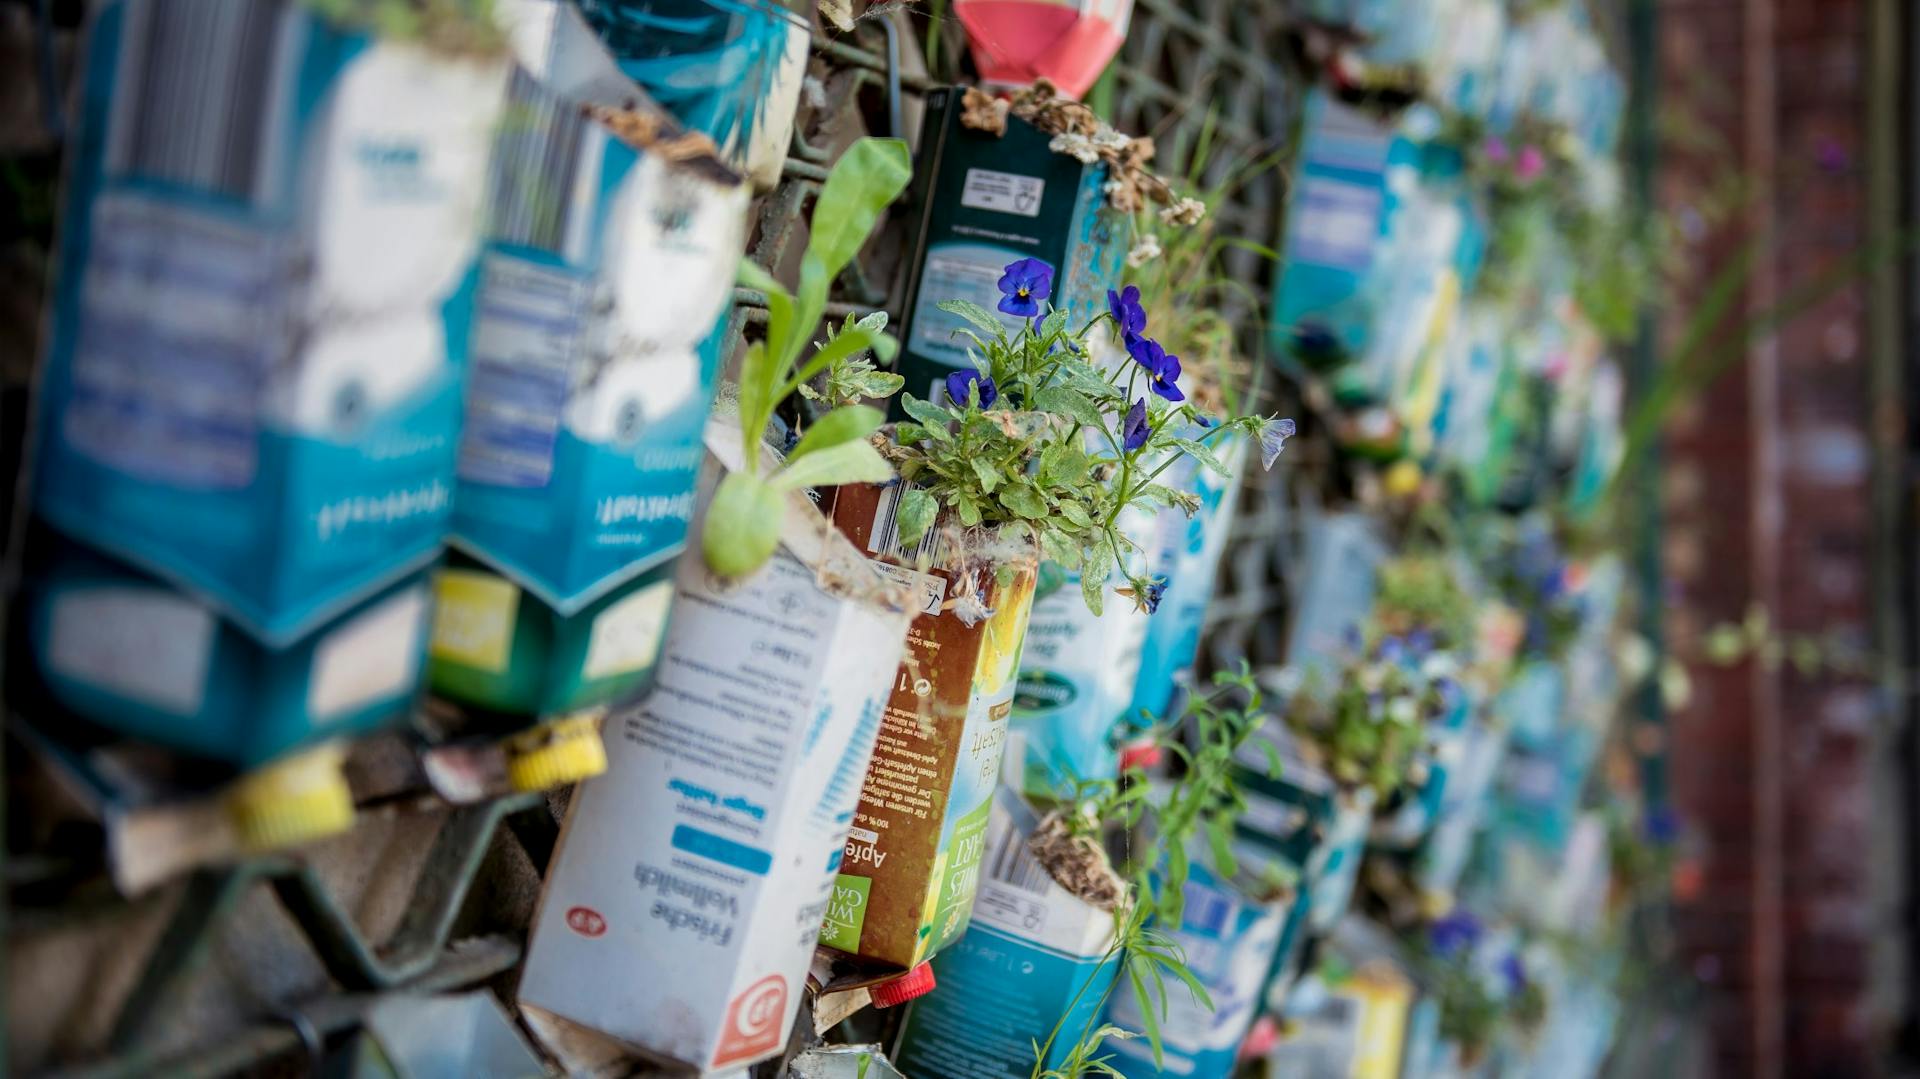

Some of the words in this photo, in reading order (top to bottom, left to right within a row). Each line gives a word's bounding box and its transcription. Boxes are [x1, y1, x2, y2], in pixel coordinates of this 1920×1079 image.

[874, 766, 919, 783] pasteurisiert
[917, 766, 938, 778] einen
[876, 779, 917, 794] gewonnene
[891, 792, 903, 802] die
[918, 788, 932, 799] Der
[885, 801, 914, 814] unseren
[904, 795, 931, 808] werden
[914, 809, 928, 819] Für
[634, 862, 740, 919] Vollmilch
[650, 900, 733, 947] Frische
